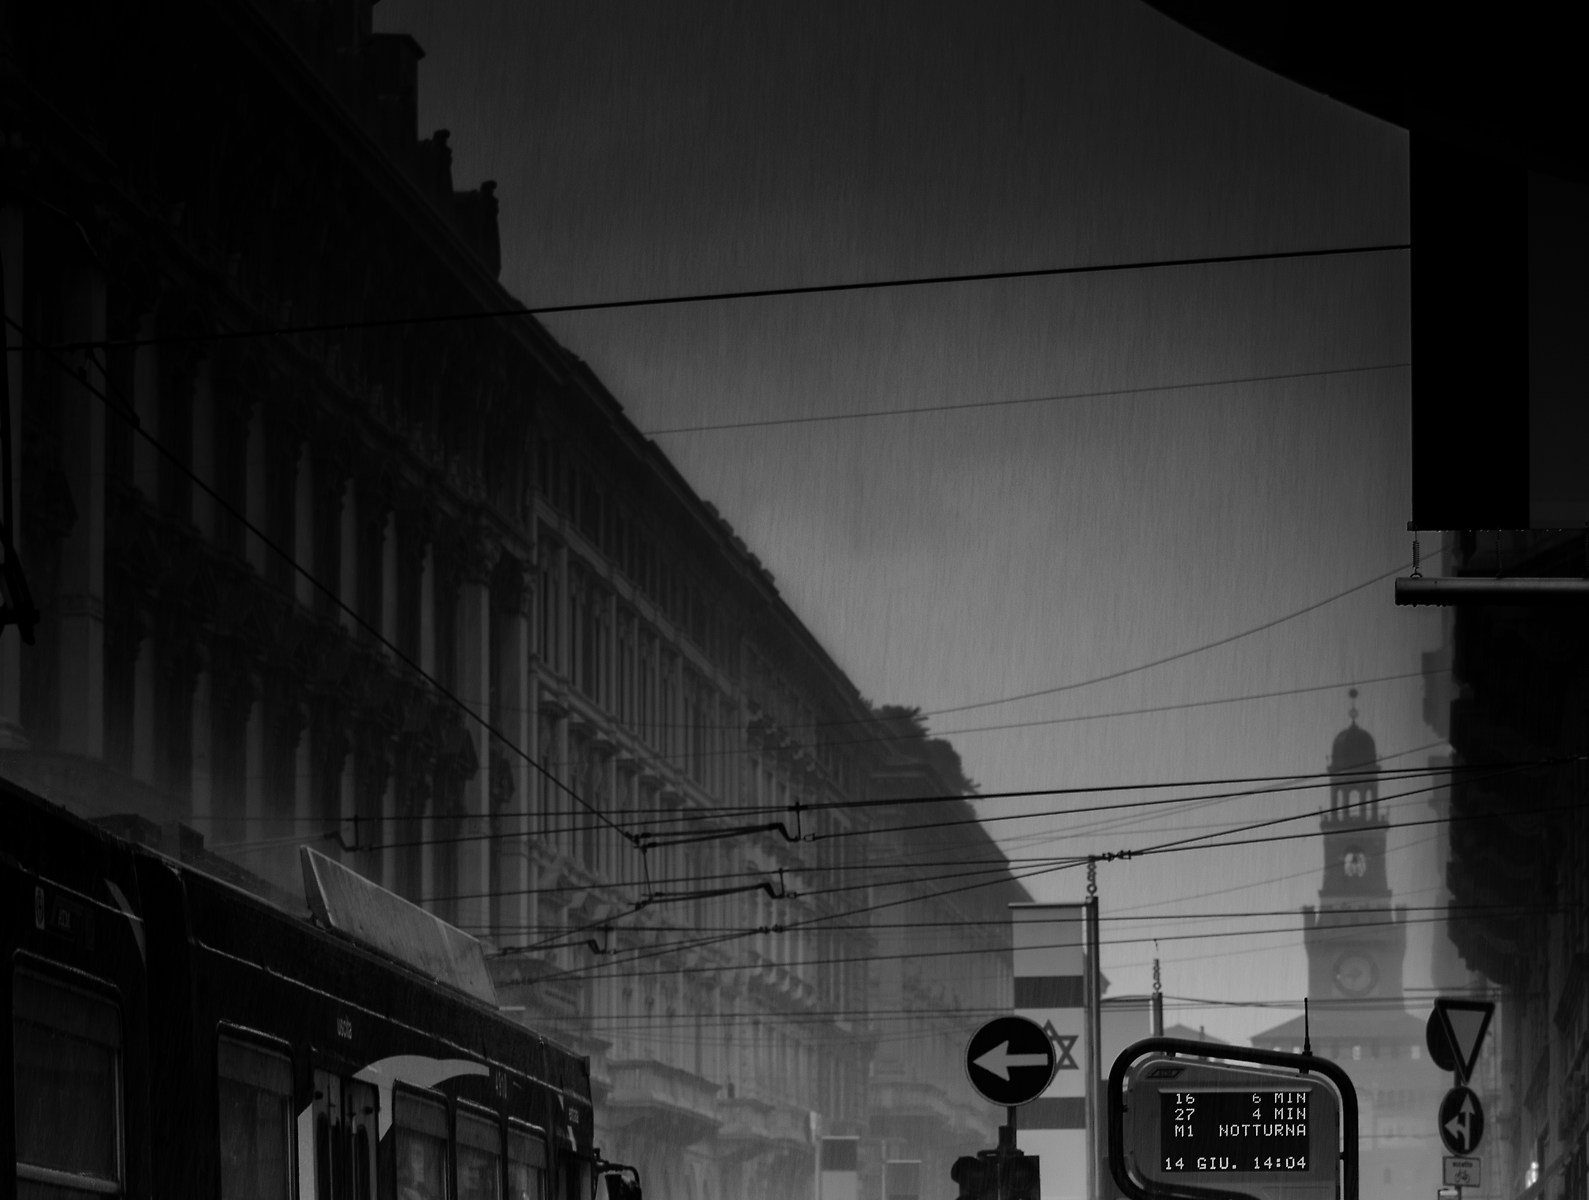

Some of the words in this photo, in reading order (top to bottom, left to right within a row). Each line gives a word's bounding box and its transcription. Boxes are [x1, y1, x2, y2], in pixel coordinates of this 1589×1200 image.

[1176, 1093, 1195, 1105] 16
[1252, 1093, 1262, 1104] 6
[1274, 1092, 1306, 1104] MIN
[1174, 1108, 1196, 1121] 27
[1252, 1107, 1262, 1120] 4
[1274, 1107, 1306, 1120] MIN
[1174, 1124, 1194, 1137] M1
[1219, 1123, 1306, 1137] NOTTURNA
[1165, 1157, 1185, 1170] 14
[1197, 1157, 1237, 1170] GIU.
[1254, 1156, 1306, 1169] 14:04
